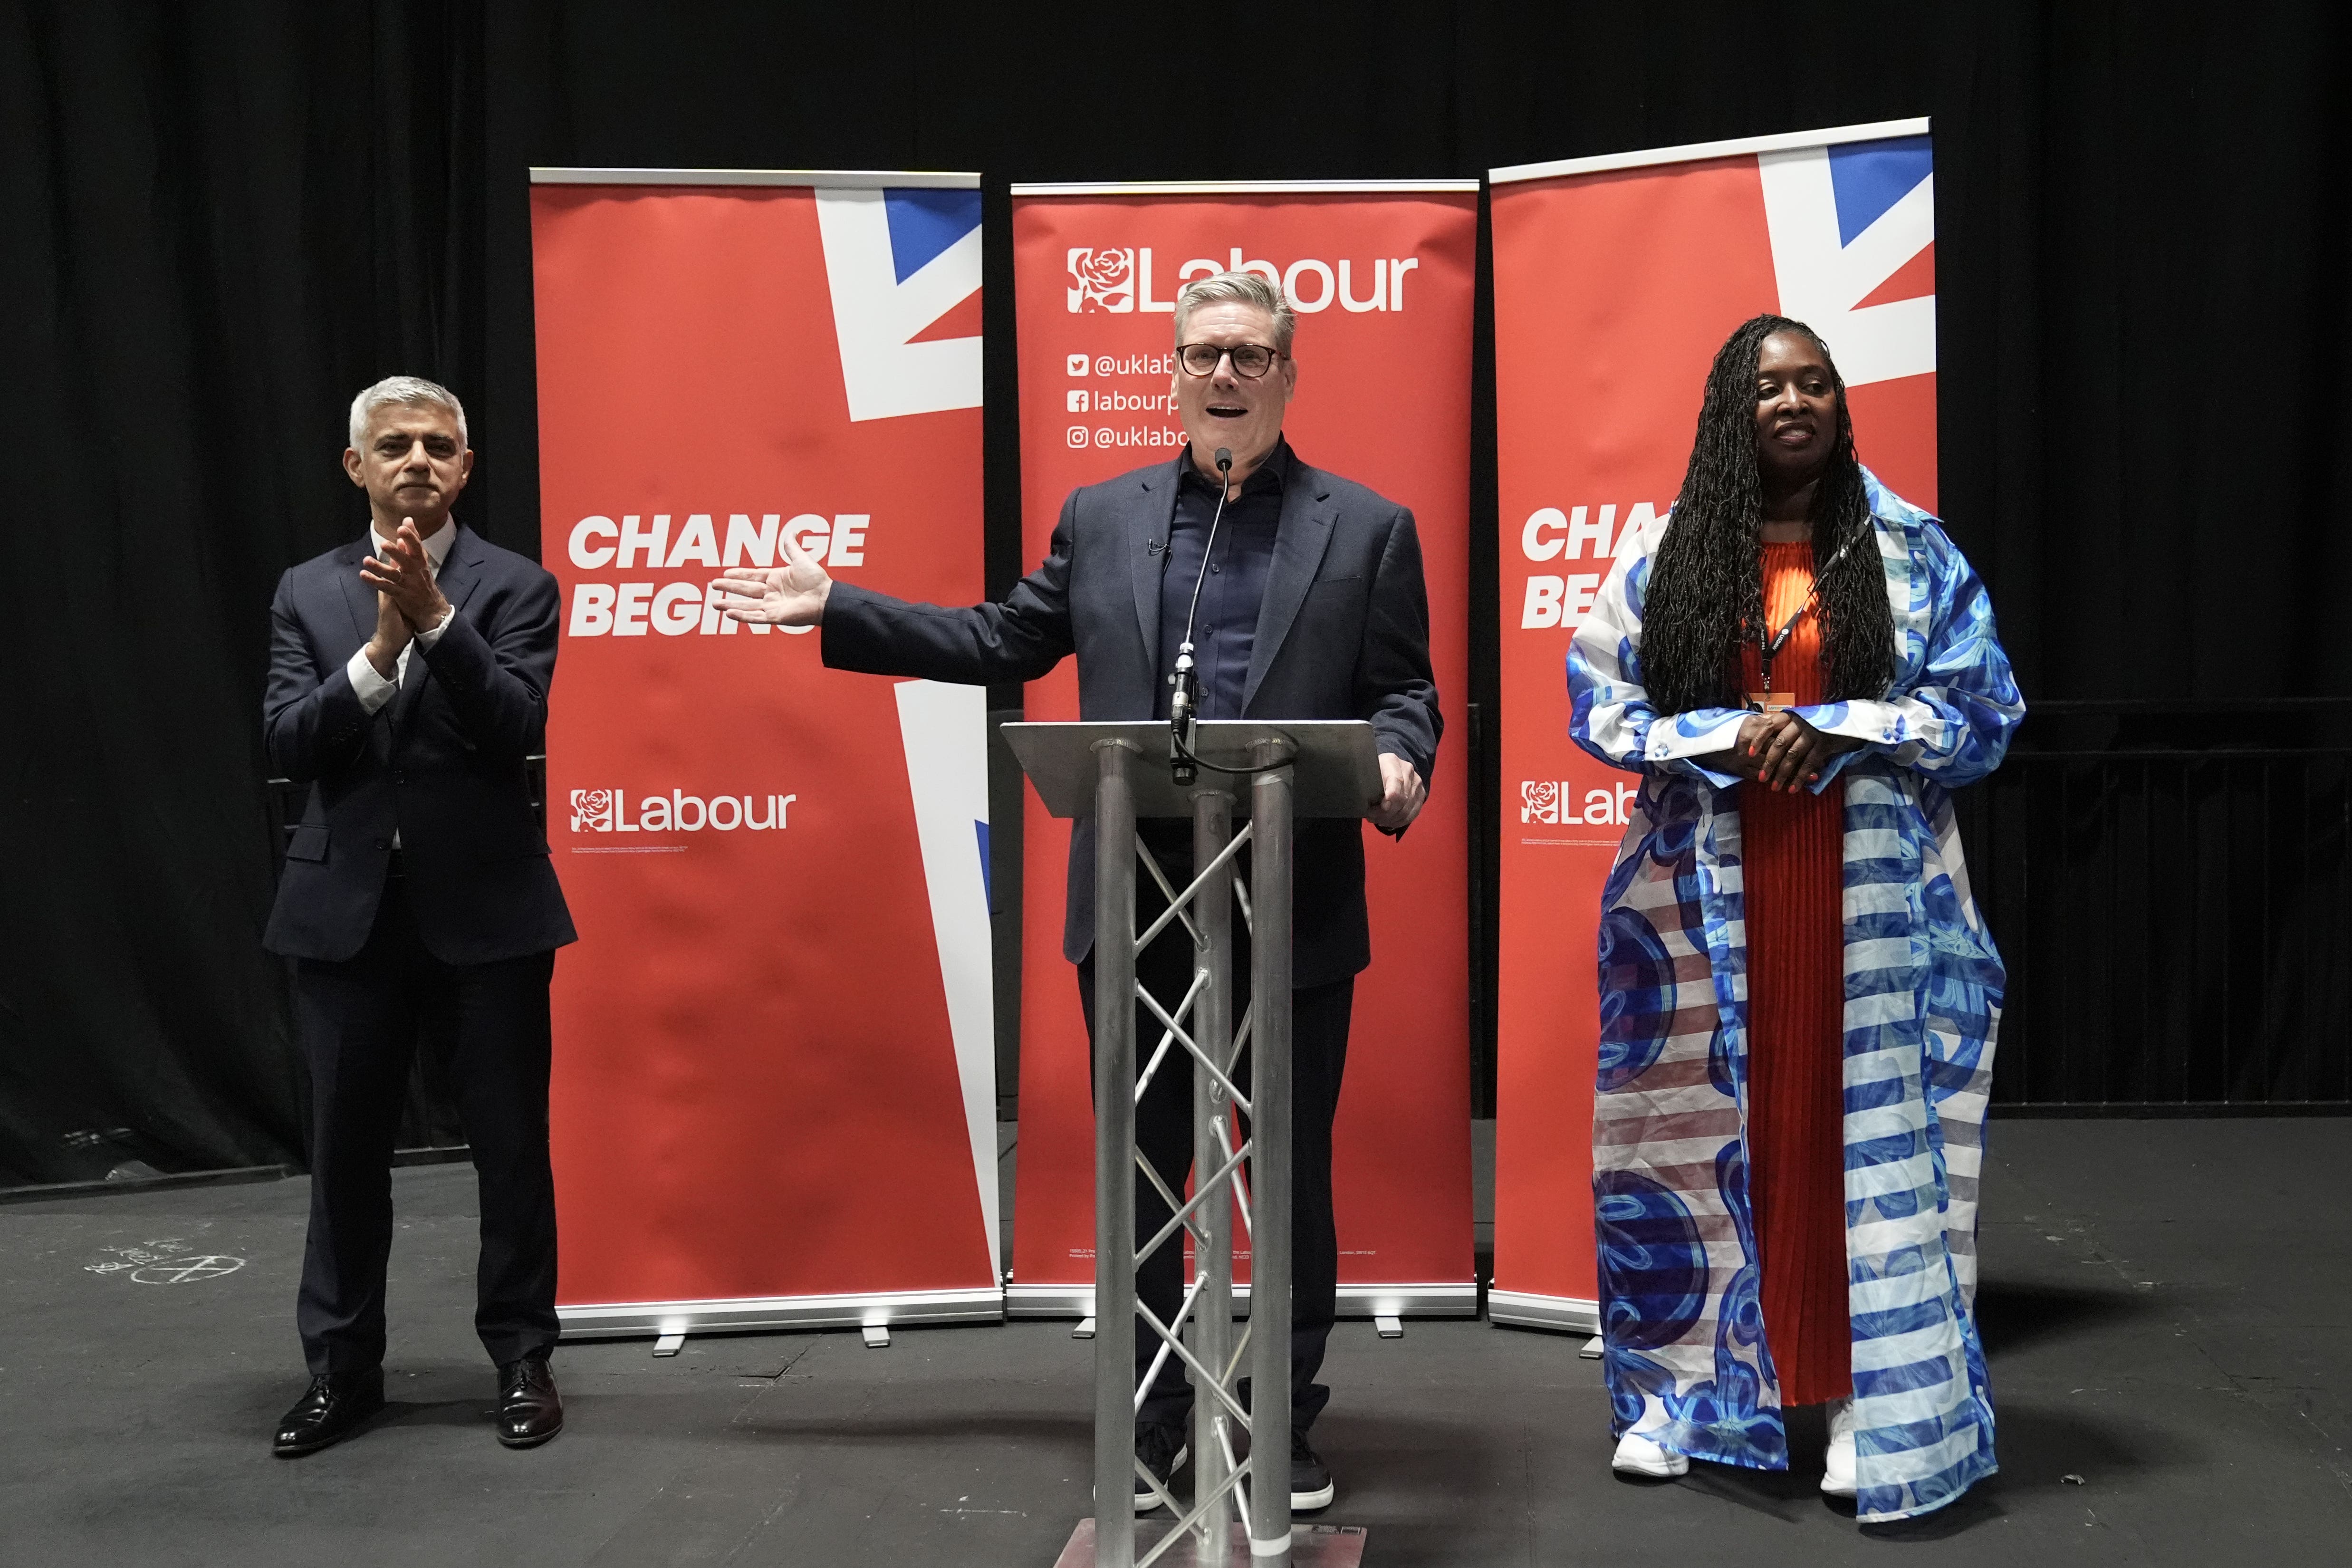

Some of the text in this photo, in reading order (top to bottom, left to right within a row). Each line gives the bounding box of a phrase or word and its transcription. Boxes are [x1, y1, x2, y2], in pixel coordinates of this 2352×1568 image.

[568, 514, 870, 569] CHANGE
[1522, 501, 1678, 562] CHA
[615, 789, 797, 831] Labour
